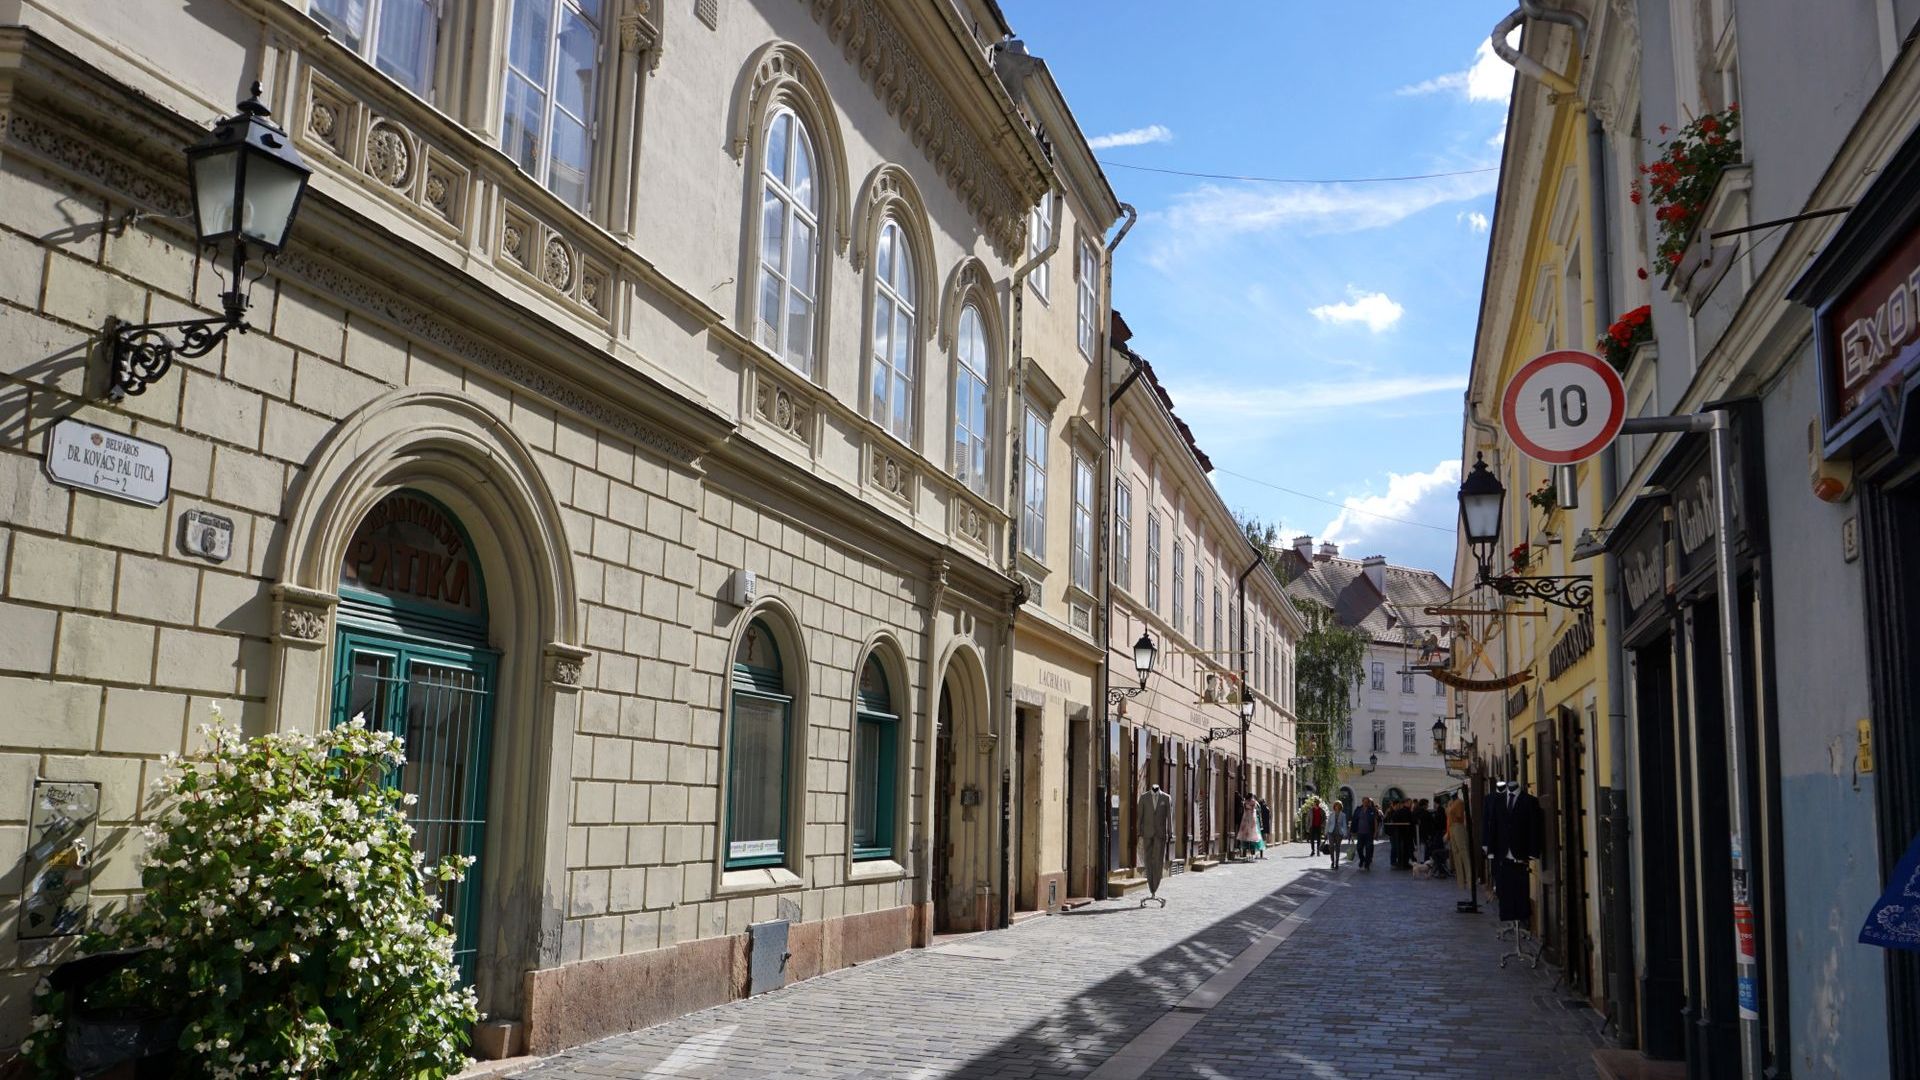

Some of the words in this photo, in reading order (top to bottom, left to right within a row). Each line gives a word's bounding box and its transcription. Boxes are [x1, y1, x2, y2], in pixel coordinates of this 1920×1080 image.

[1540, 384, 1588, 429] 10
[105, 438, 140, 457] BELVÁROS
[67, 444, 81, 462] DR.
[83, 449, 115, 471] KOVÁCS
[117, 456, 131, 476] PÁL
[134, 463, 154, 482] UTCA
[94, 471, 99, 485] 6
[121, 478, 127, 492] 2
[201, 527, 216, 553] 6
